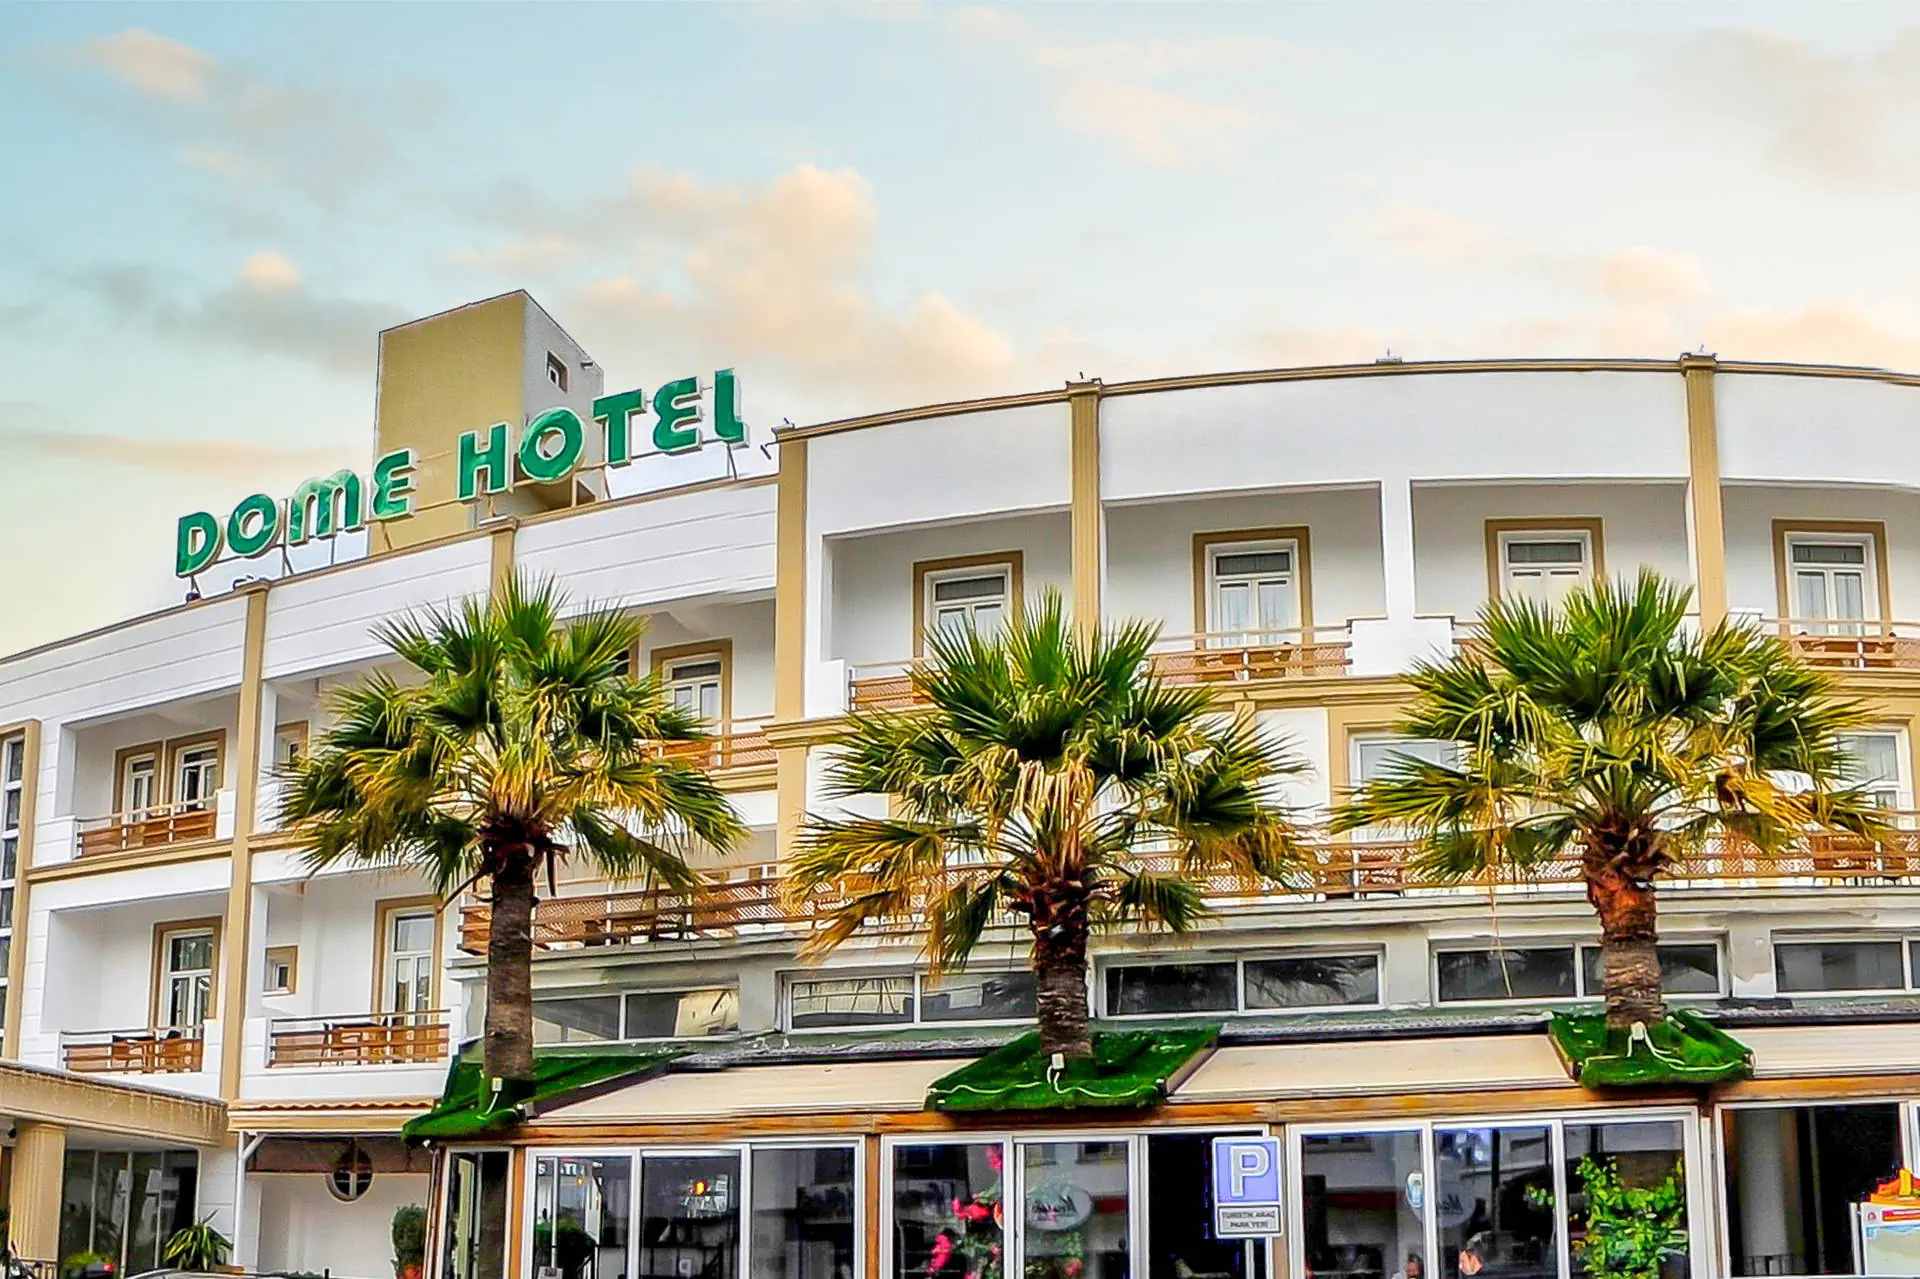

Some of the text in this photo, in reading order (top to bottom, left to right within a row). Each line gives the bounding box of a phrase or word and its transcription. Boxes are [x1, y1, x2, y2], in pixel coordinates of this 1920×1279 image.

[176, 368, 747, 577] DOME HOTEL
[1230, 1145, 1270, 1197] P
